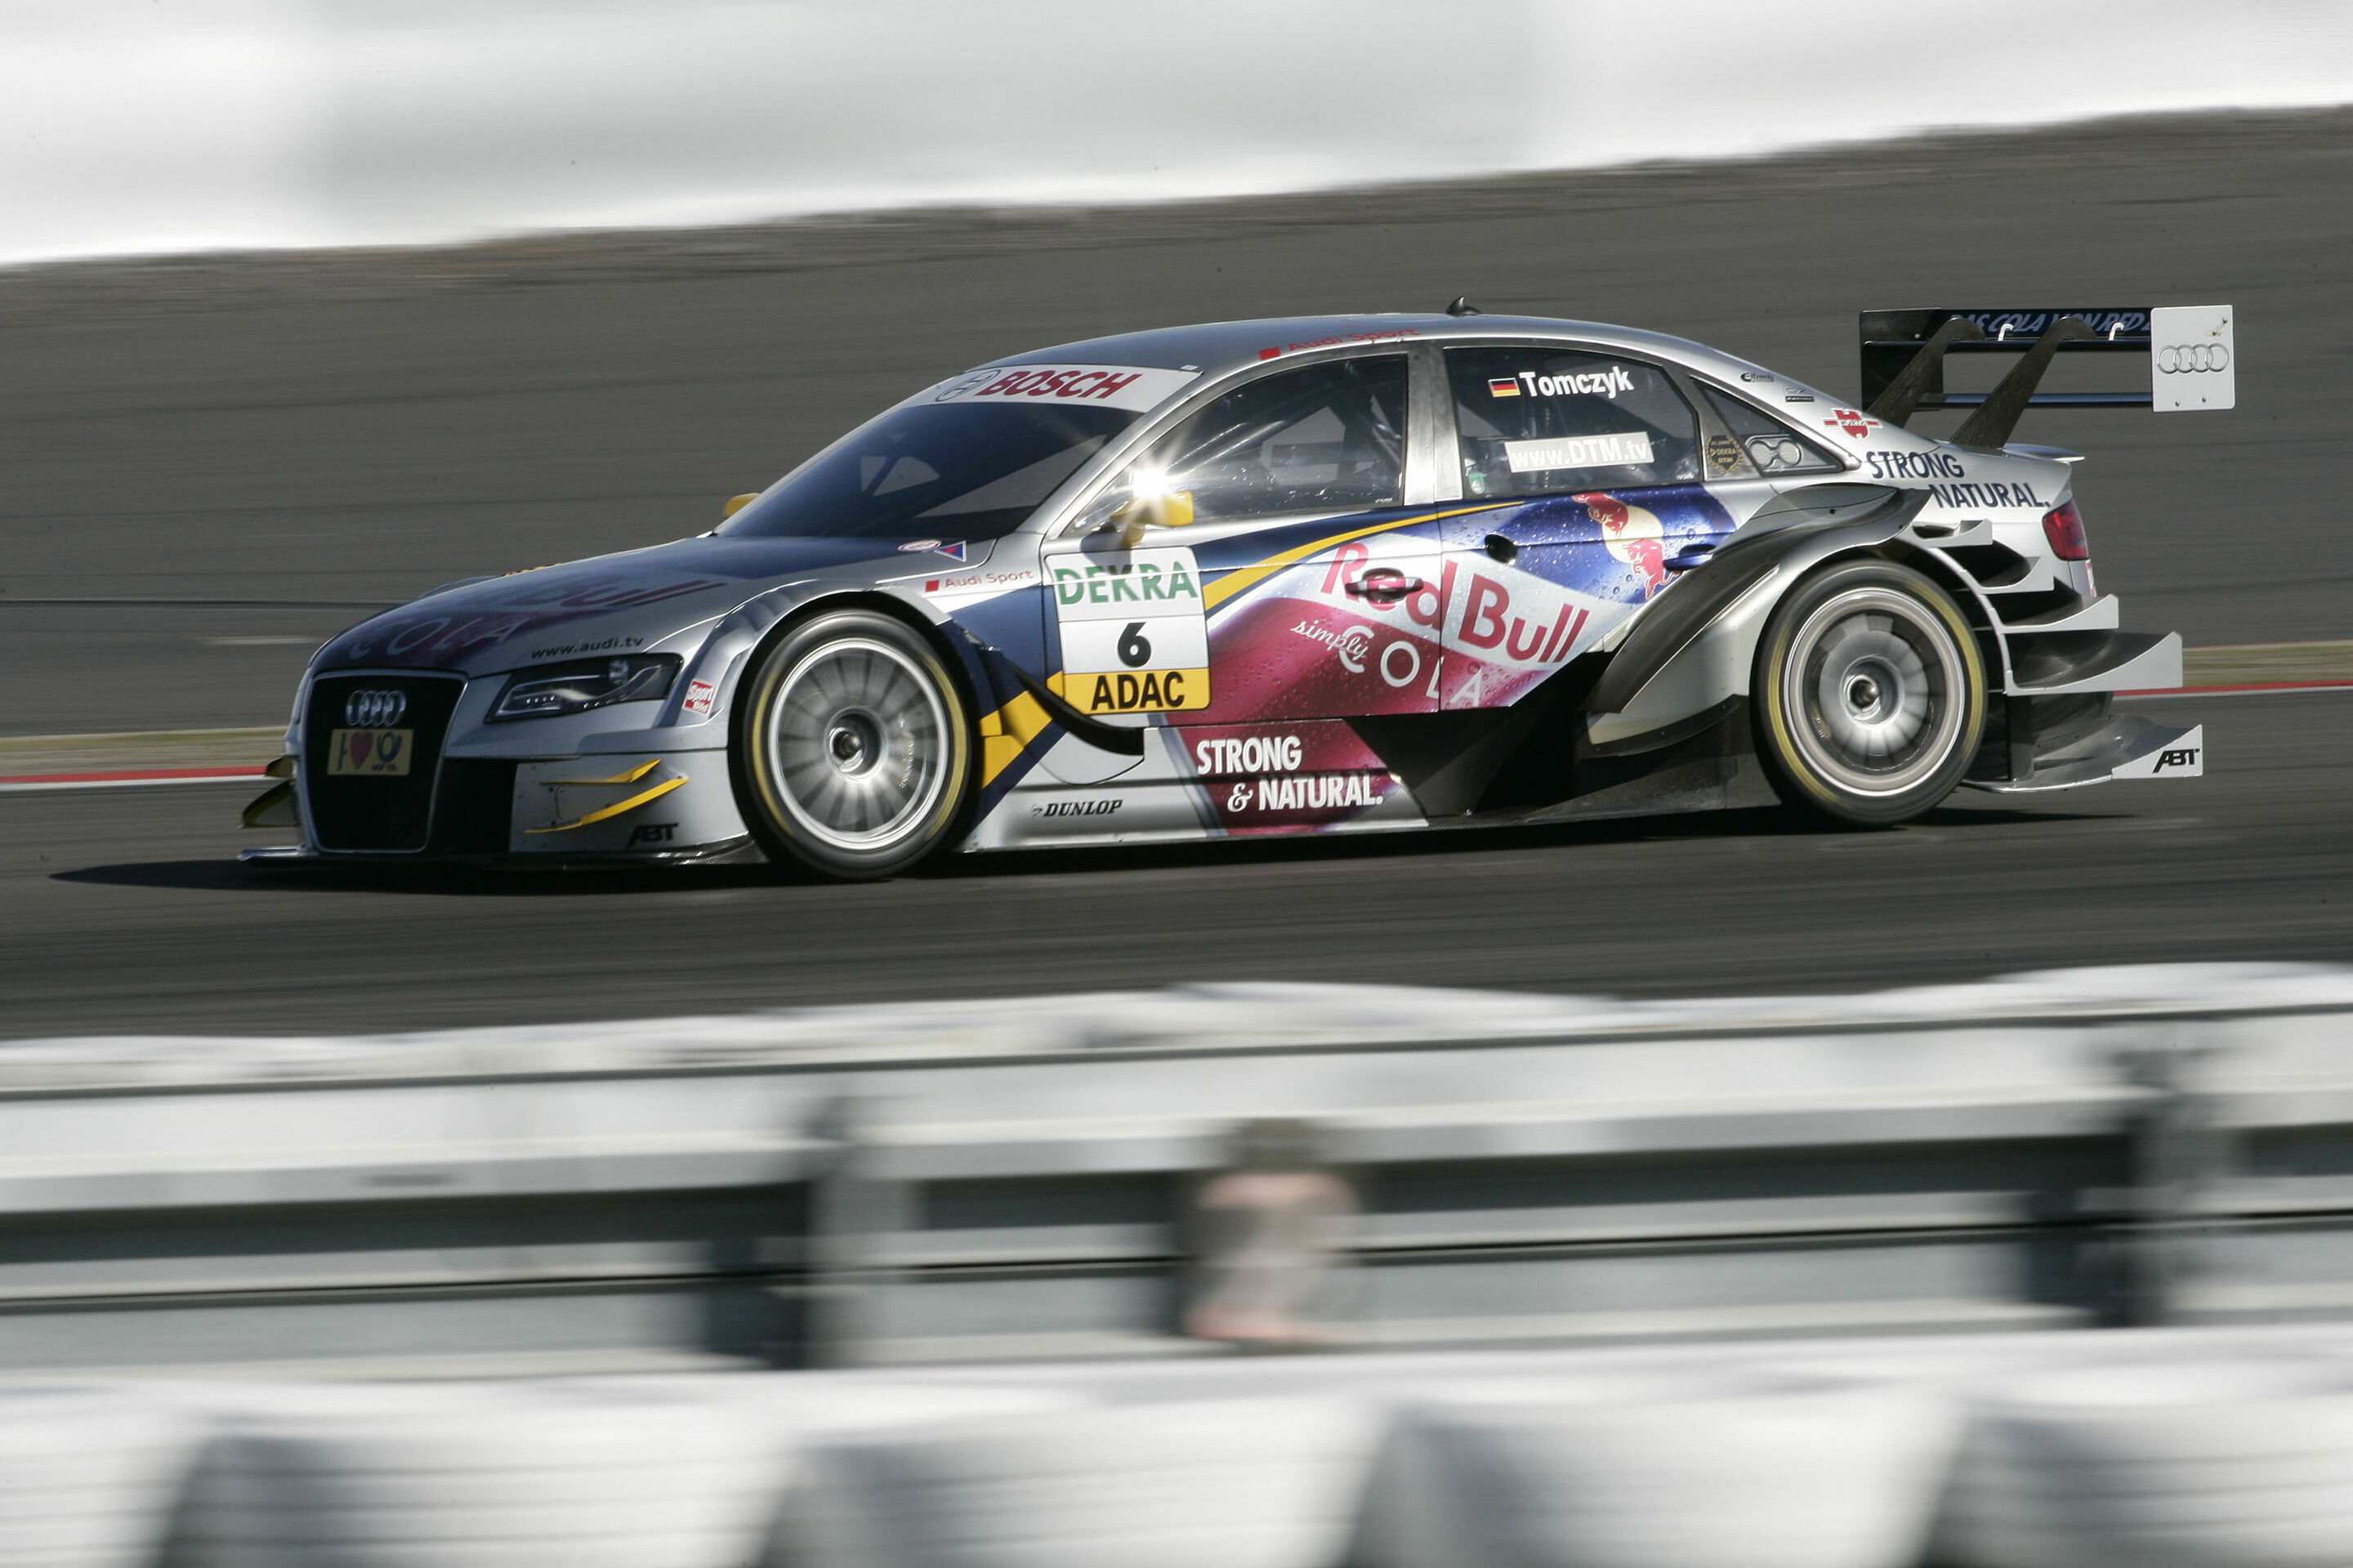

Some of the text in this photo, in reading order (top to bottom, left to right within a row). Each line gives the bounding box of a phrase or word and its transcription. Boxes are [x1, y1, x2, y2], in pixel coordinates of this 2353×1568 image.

[1988, 313, 2047, 333] COLA
[1288, 328, 1422, 351] Audi Sport
[973, 369, 1143, 399] BOSCH
[1518, 366, 1635, 400] Tomczyk
[1511, 438, 1648, 470] www.DTM.tv
[1866, 451, 1965, 479] STRONG
[945, 570, 1034, 588] Audi Sport
[1053, 561, 1199, 605] DEKRA
[1458, 572, 1590, 664] Bull
[531, 636, 645, 659] www.audi.tv
[1117, 622, 1152, 668] 6
[1290, 619, 1369, 661] simply
[1338, 625, 1484, 708] COLA
[1091, 671, 1185, 711] ADAC
[1196, 735, 1302, 775] STRONG
[2152, 748, 2201, 774] ABT
[1045, 799, 1123, 816] DUNLOP
[1227, 773, 1385, 813] & NATURAL.
[626, 822, 680, 849] ABT
